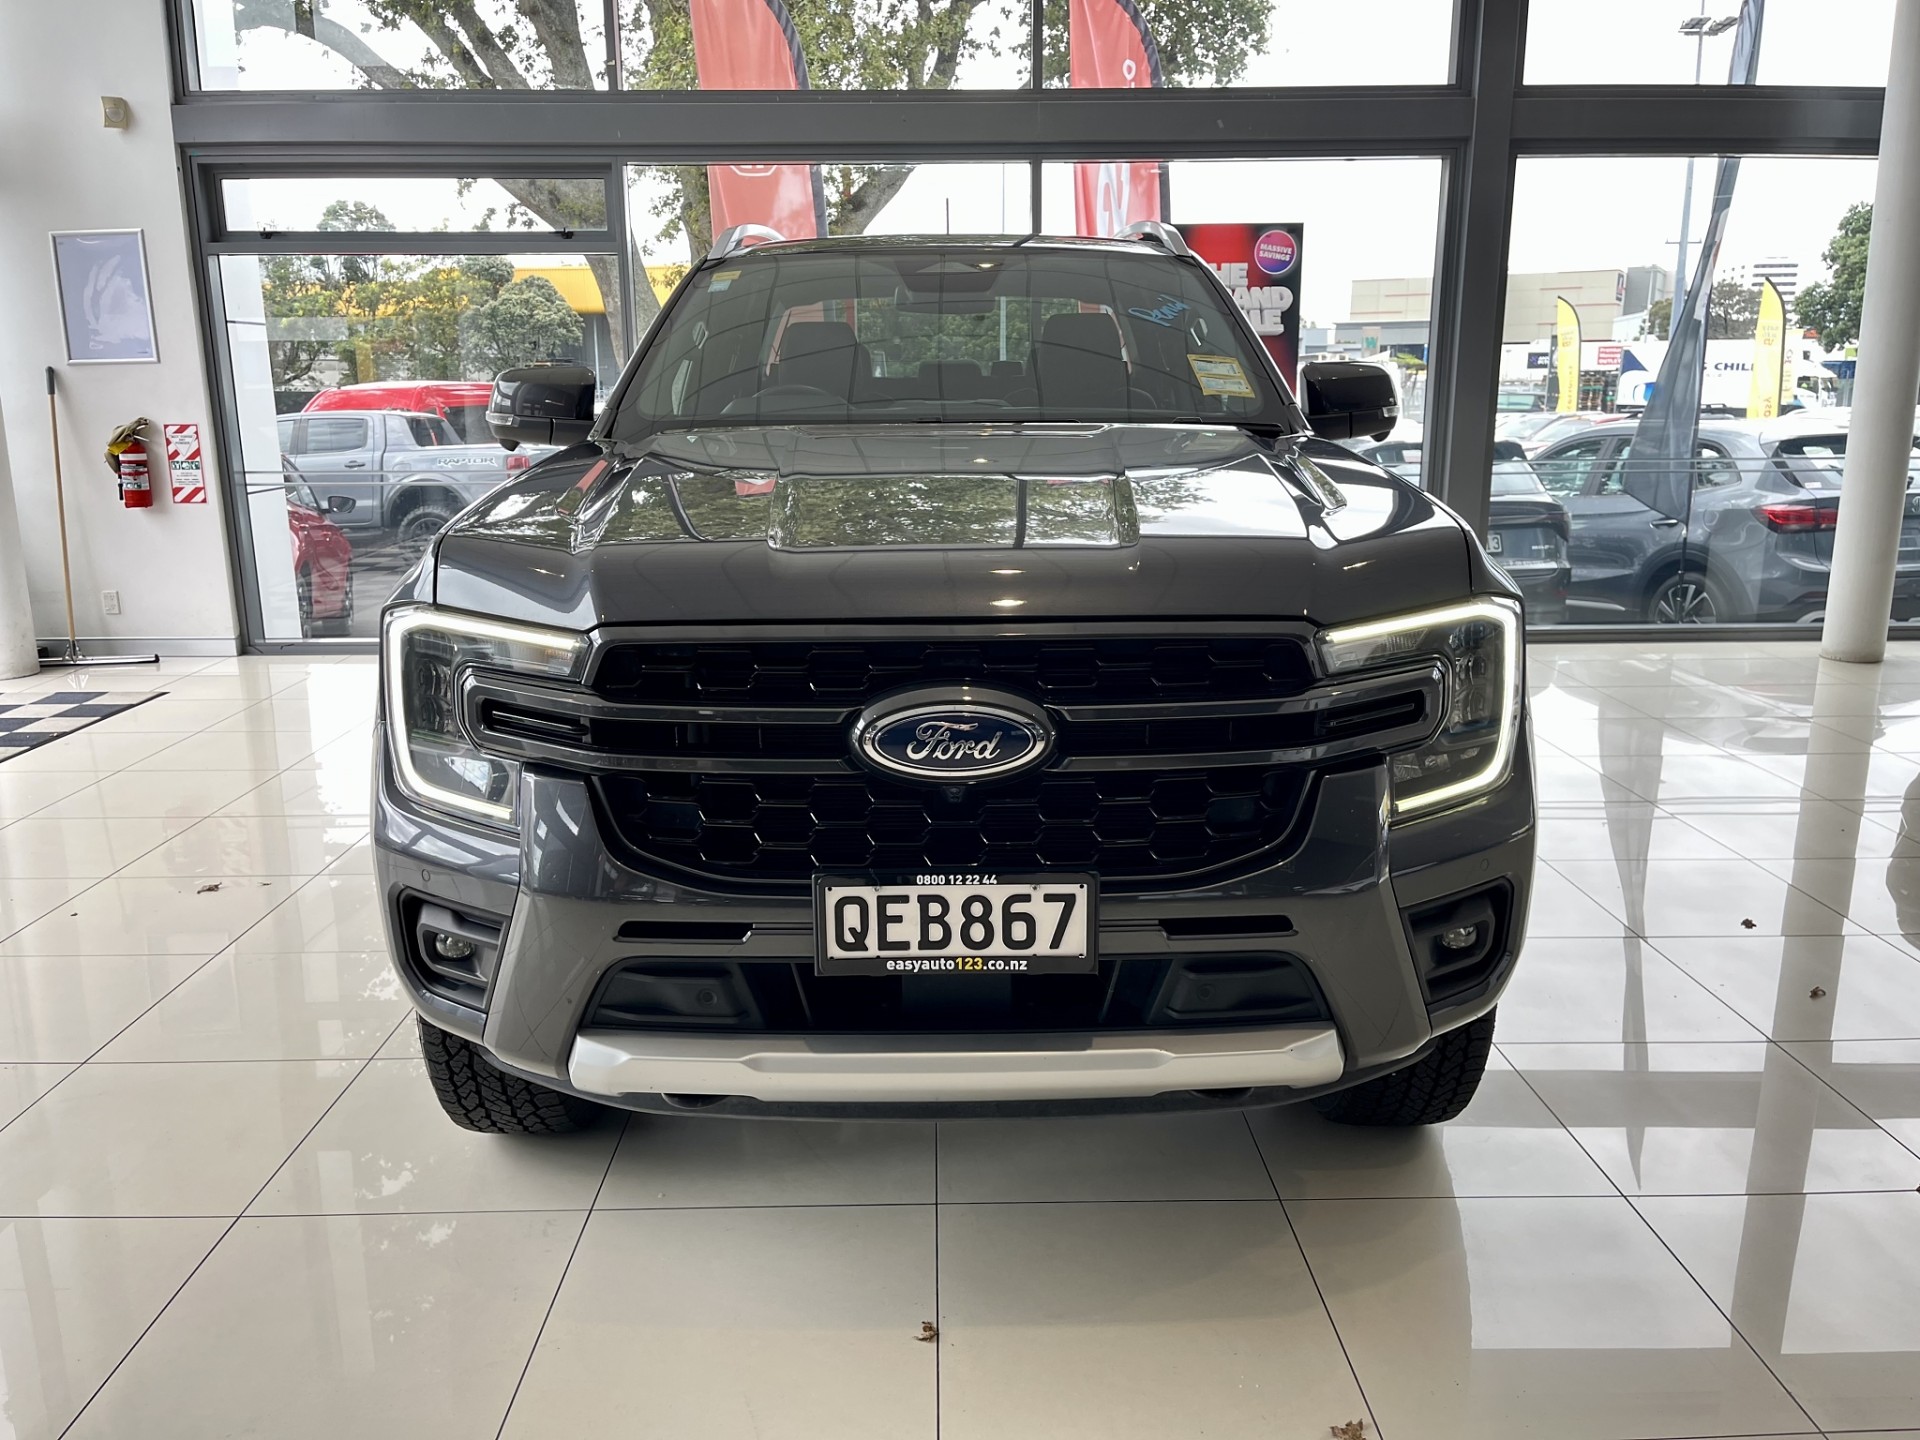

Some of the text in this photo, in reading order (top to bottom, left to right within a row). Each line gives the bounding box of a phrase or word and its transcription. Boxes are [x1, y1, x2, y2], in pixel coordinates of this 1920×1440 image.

[1259, 250, 1291, 262] SAVINGS
[1260, 243, 1292, 254] MASSIVE
[1209, 262, 1248, 289] HE
[1227, 286, 1293, 312] AND
[1243, 309, 1284, 336] LE
[437, 456, 498, 469] RAPTOR
[906, 721, 1003, 760] Ford
[916, 874, 998, 885] 0800 12 22 44
[834, 893, 1077, 952] QEB867
[886, 957, 1028, 974] easyauto123.co.nz
